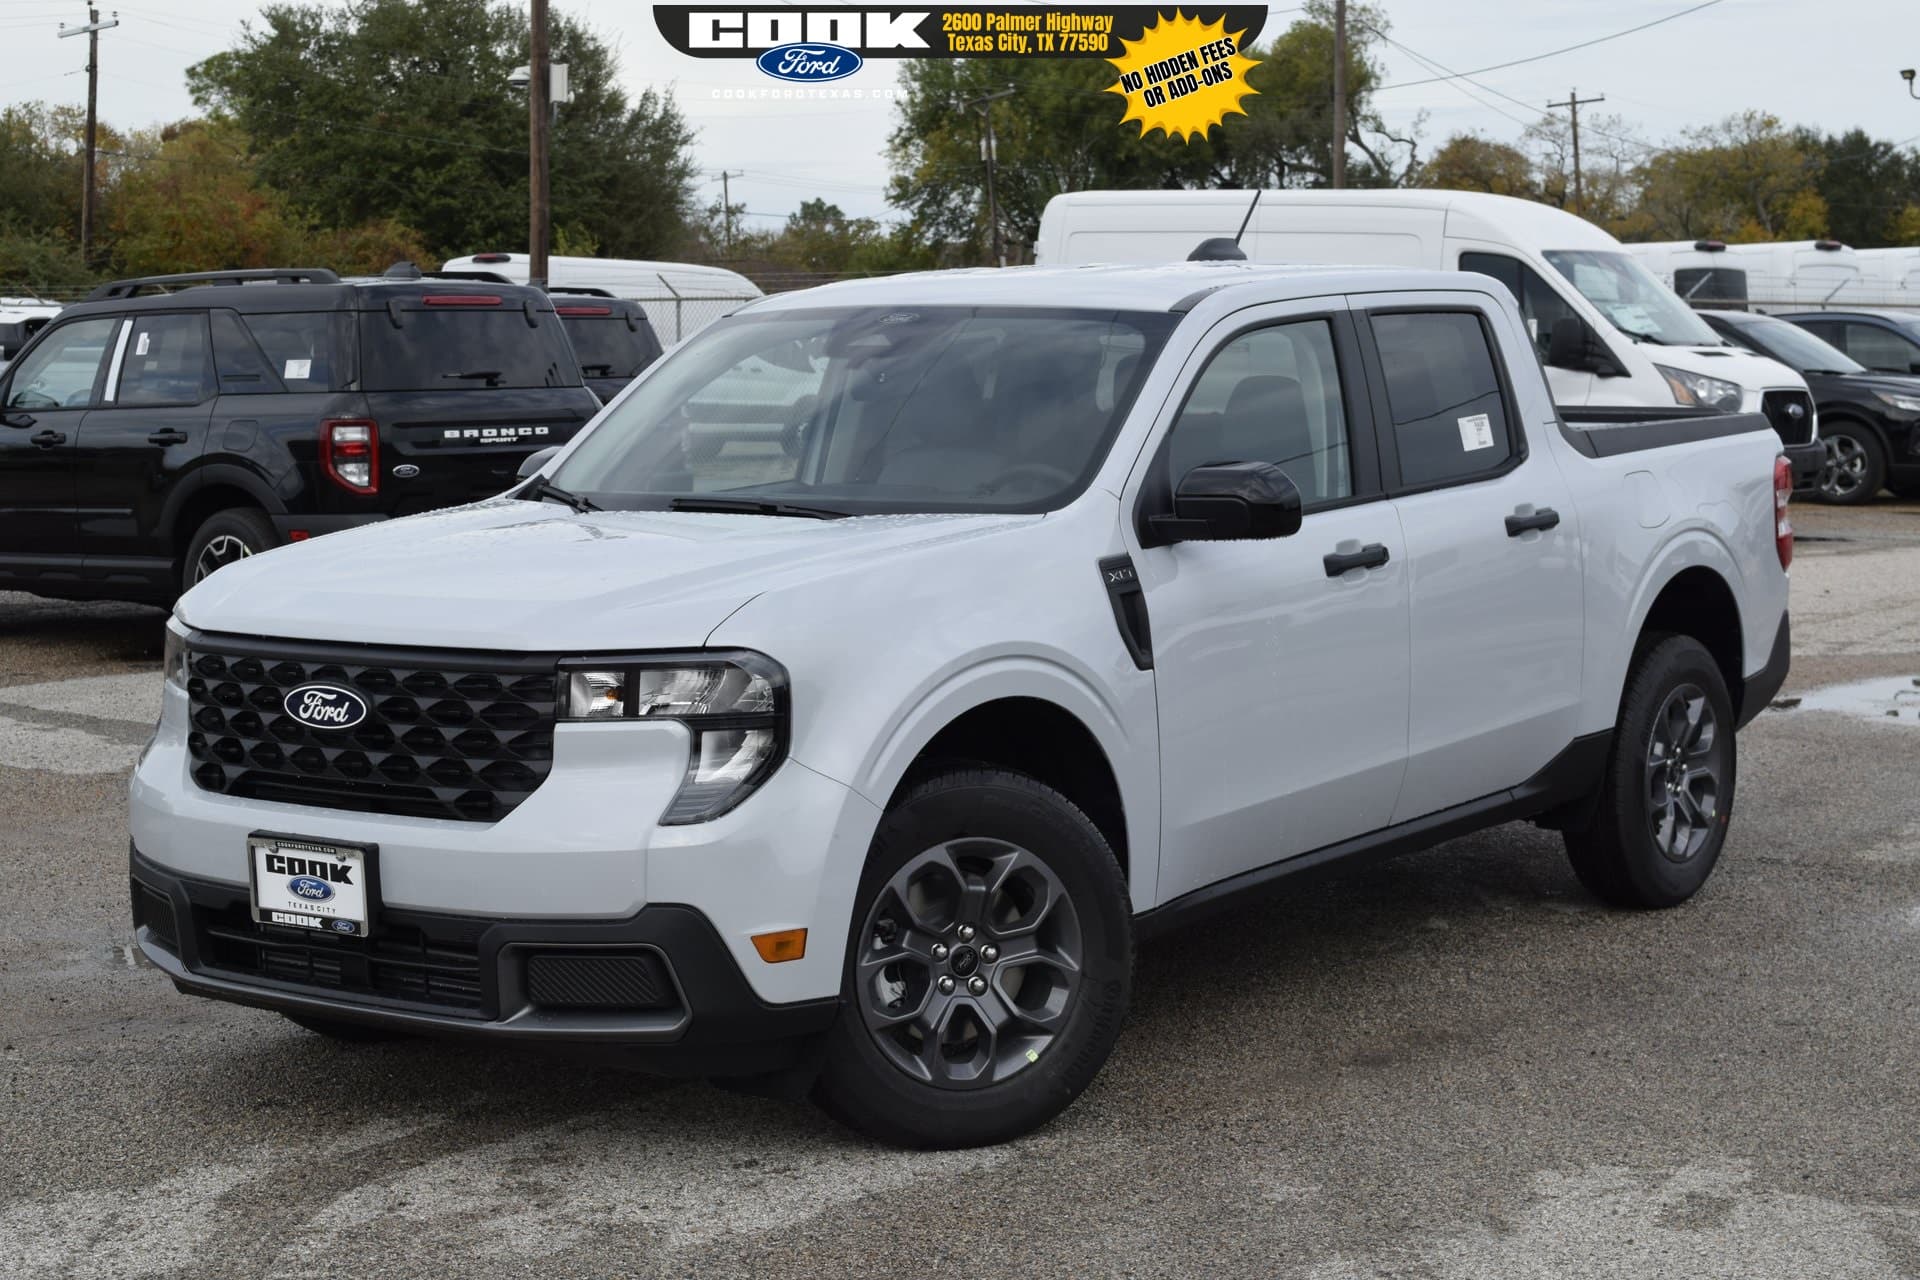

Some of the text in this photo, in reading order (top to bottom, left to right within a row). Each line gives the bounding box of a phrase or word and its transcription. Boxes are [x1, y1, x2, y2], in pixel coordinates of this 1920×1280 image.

[444, 426, 549, 438] BRONCO
[299, 690, 350, 722] Ford
[265, 853, 354, 885] COOK
[297, 879, 324, 898] Ford
[271, 911, 323, 928] COOK
